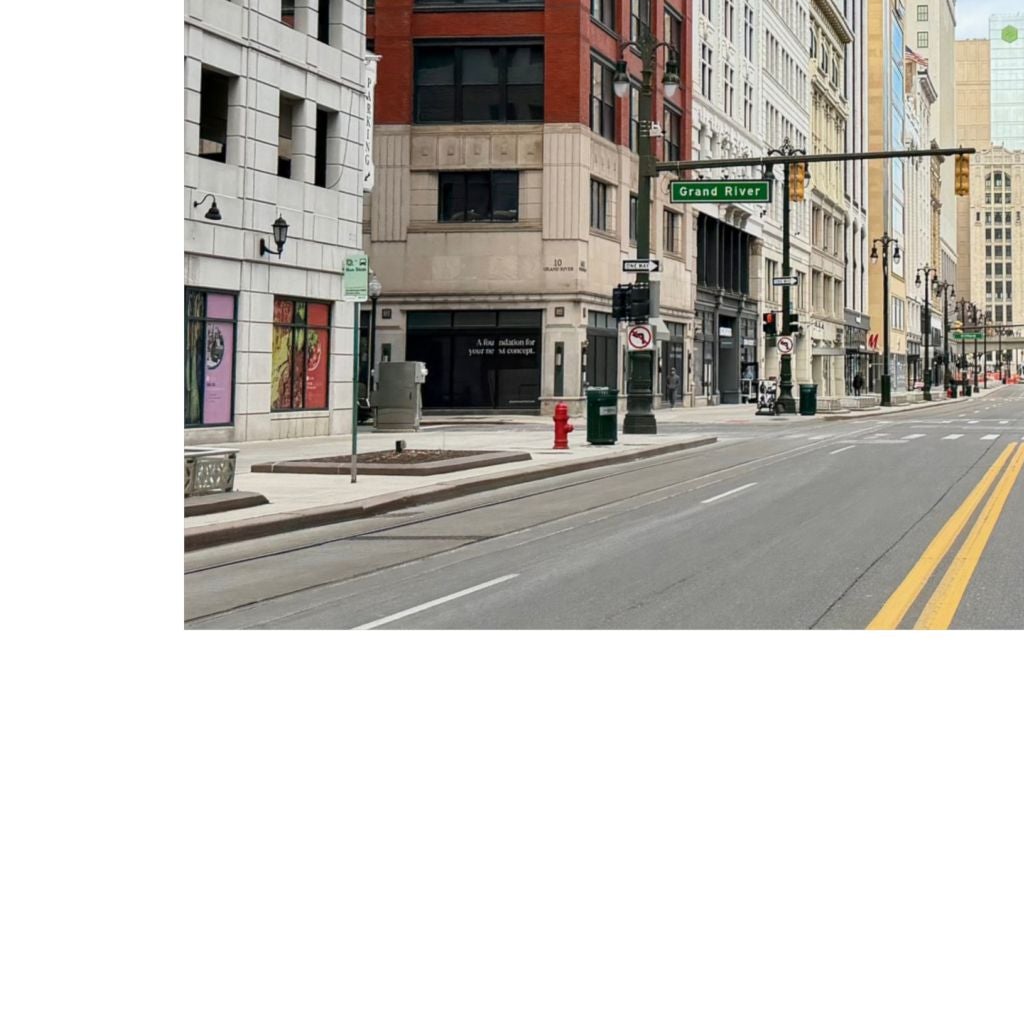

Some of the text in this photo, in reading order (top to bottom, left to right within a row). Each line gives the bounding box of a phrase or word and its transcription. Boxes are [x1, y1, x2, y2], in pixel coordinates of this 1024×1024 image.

[679, 186, 761, 196] Grand River
[554, 258, 563, 267] 10
